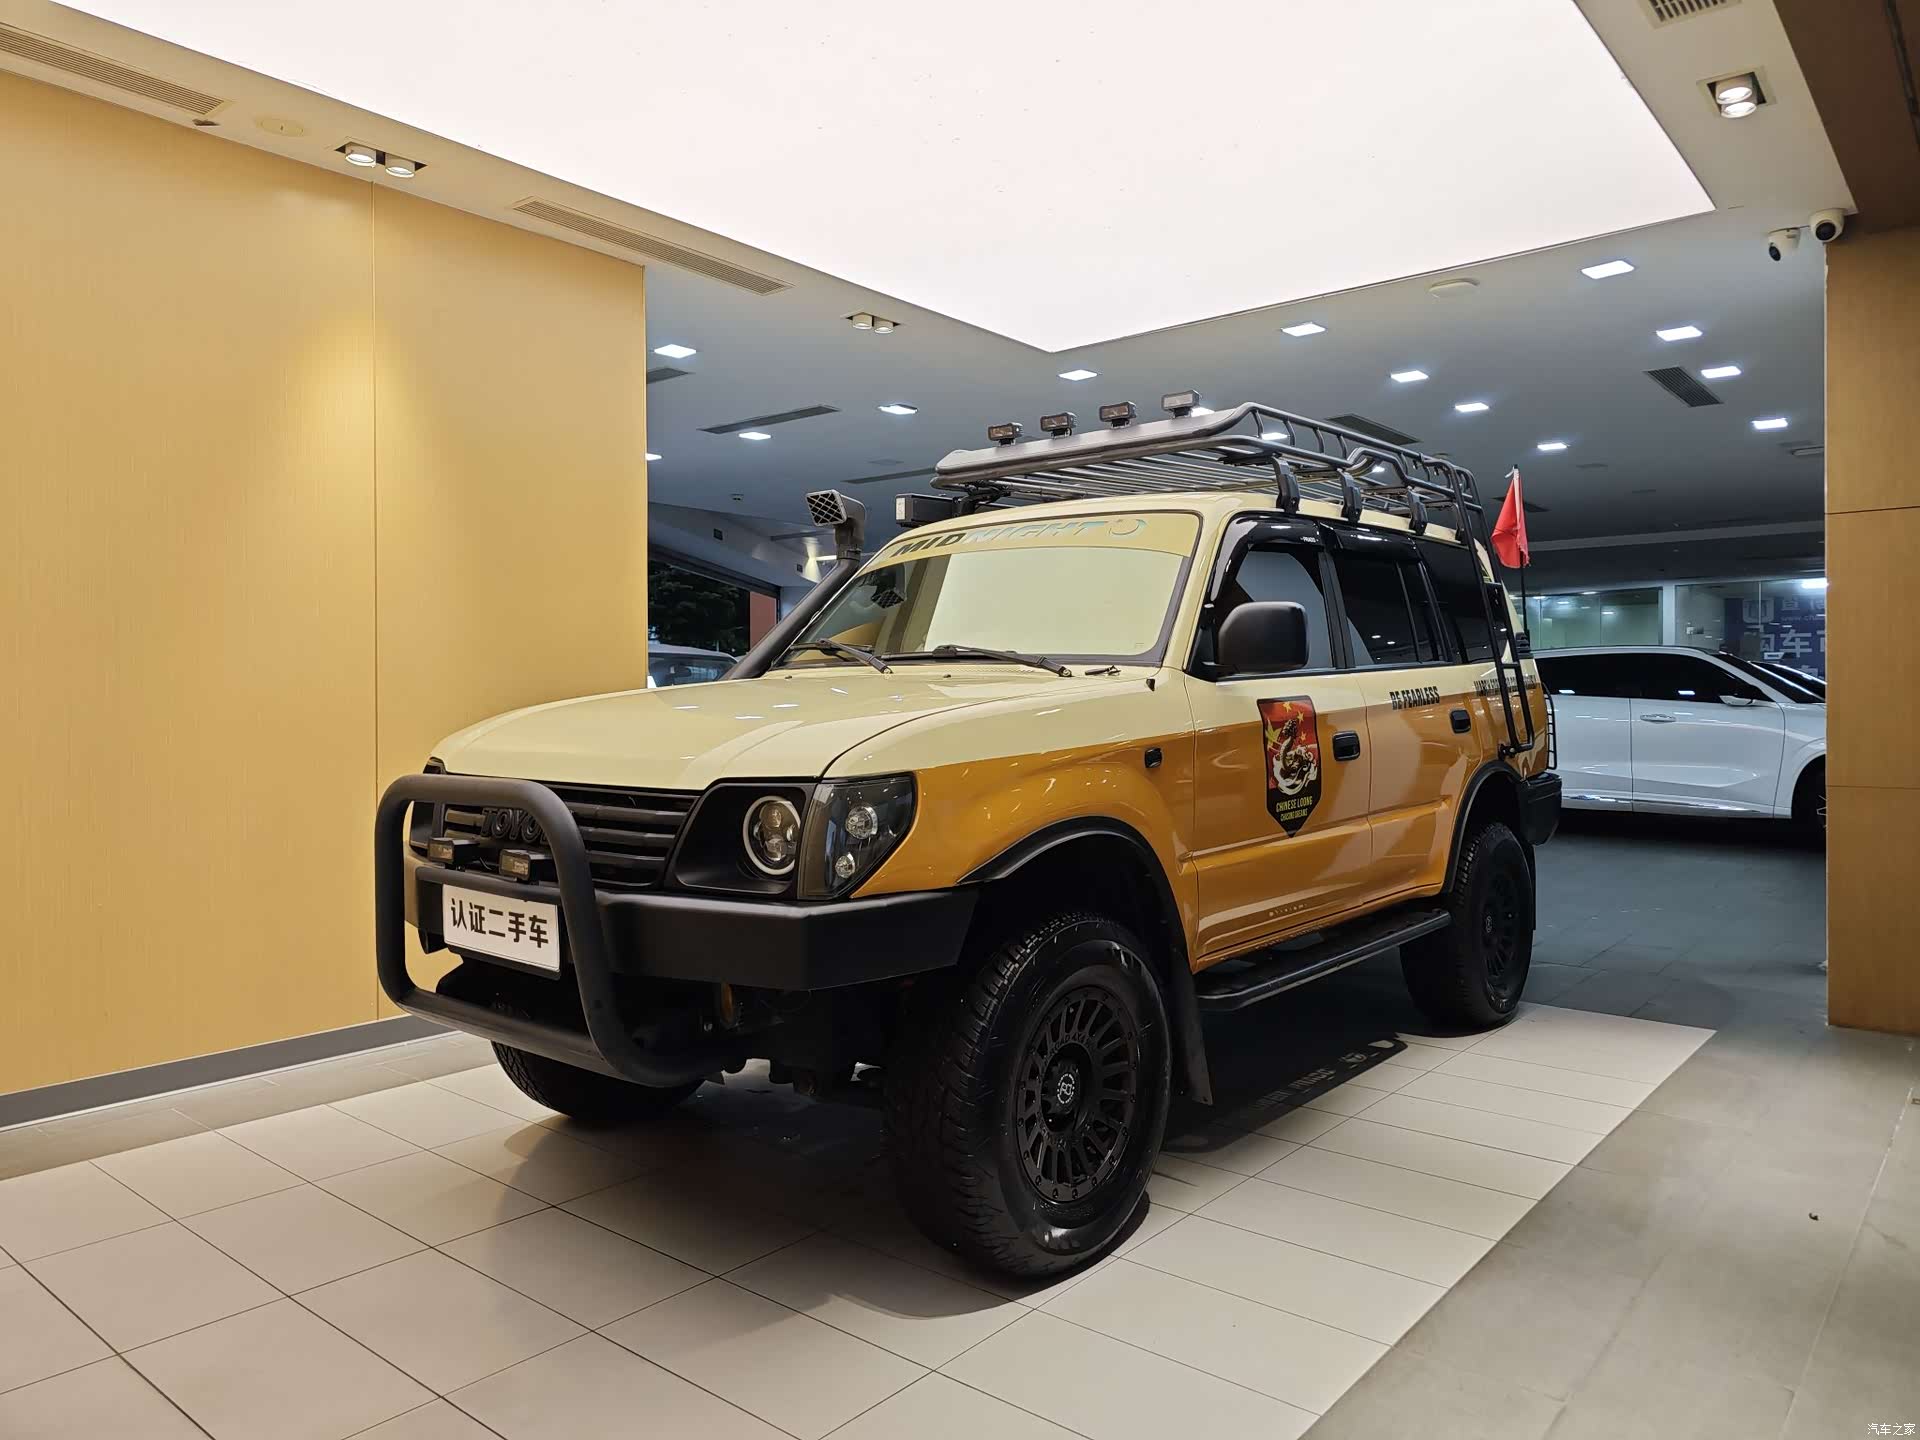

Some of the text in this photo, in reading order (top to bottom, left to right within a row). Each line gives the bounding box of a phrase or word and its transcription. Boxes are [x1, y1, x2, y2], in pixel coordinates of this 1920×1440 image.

[890, 520, 1109, 558] MIDNIGHT
[1389, 685, 1440, 711] BE FEARLESS
[480, 807, 549, 846] TOYO
[451, 898, 549, 948] 认证二手车
